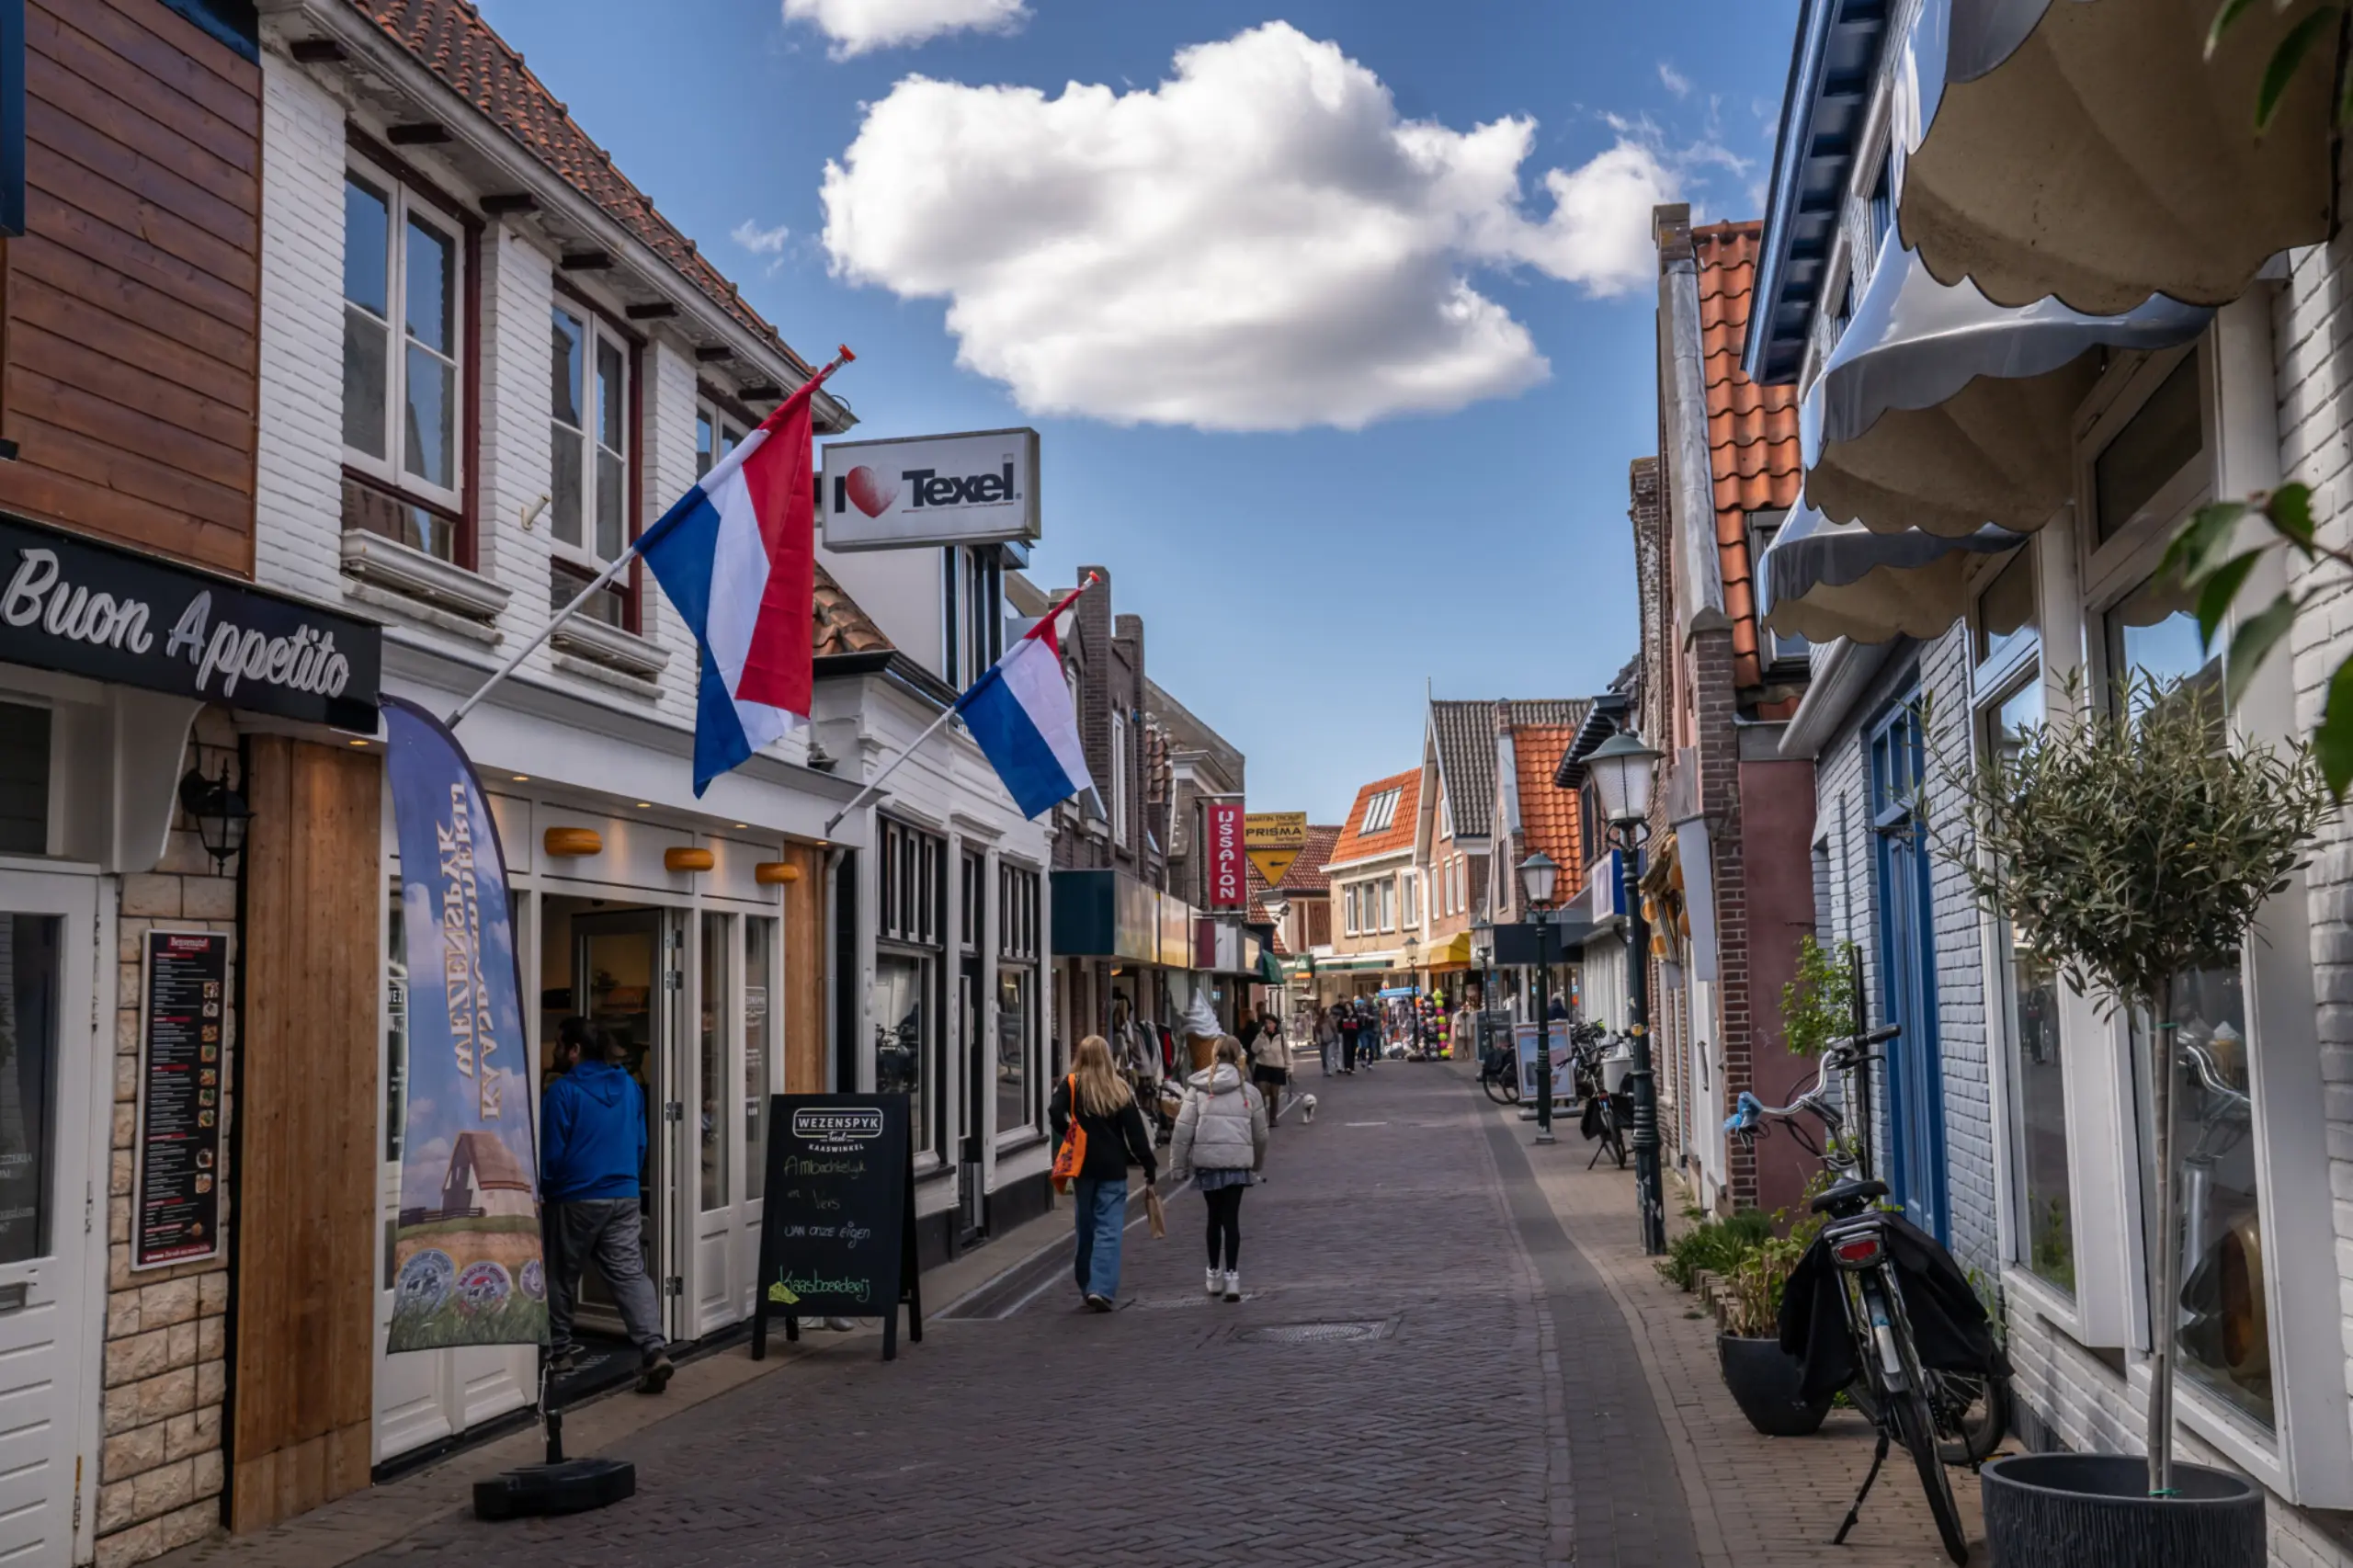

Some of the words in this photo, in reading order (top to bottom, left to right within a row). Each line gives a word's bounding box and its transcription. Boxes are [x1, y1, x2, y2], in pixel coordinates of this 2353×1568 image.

[835, 476, 846, 513] I
[902, 459, 1014, 507] Texel
[1, 549, 153, 654] Buon
[166, 590, 349, 699] Appetito
[1245, 826, 1302, 836] PRISMA
[1218, 811, 1235, 899] IJSSALON
[798, 1118, 879, 1128] WEZENSPYK
[808, 1143, 864, 1153] KAASWINKEL
